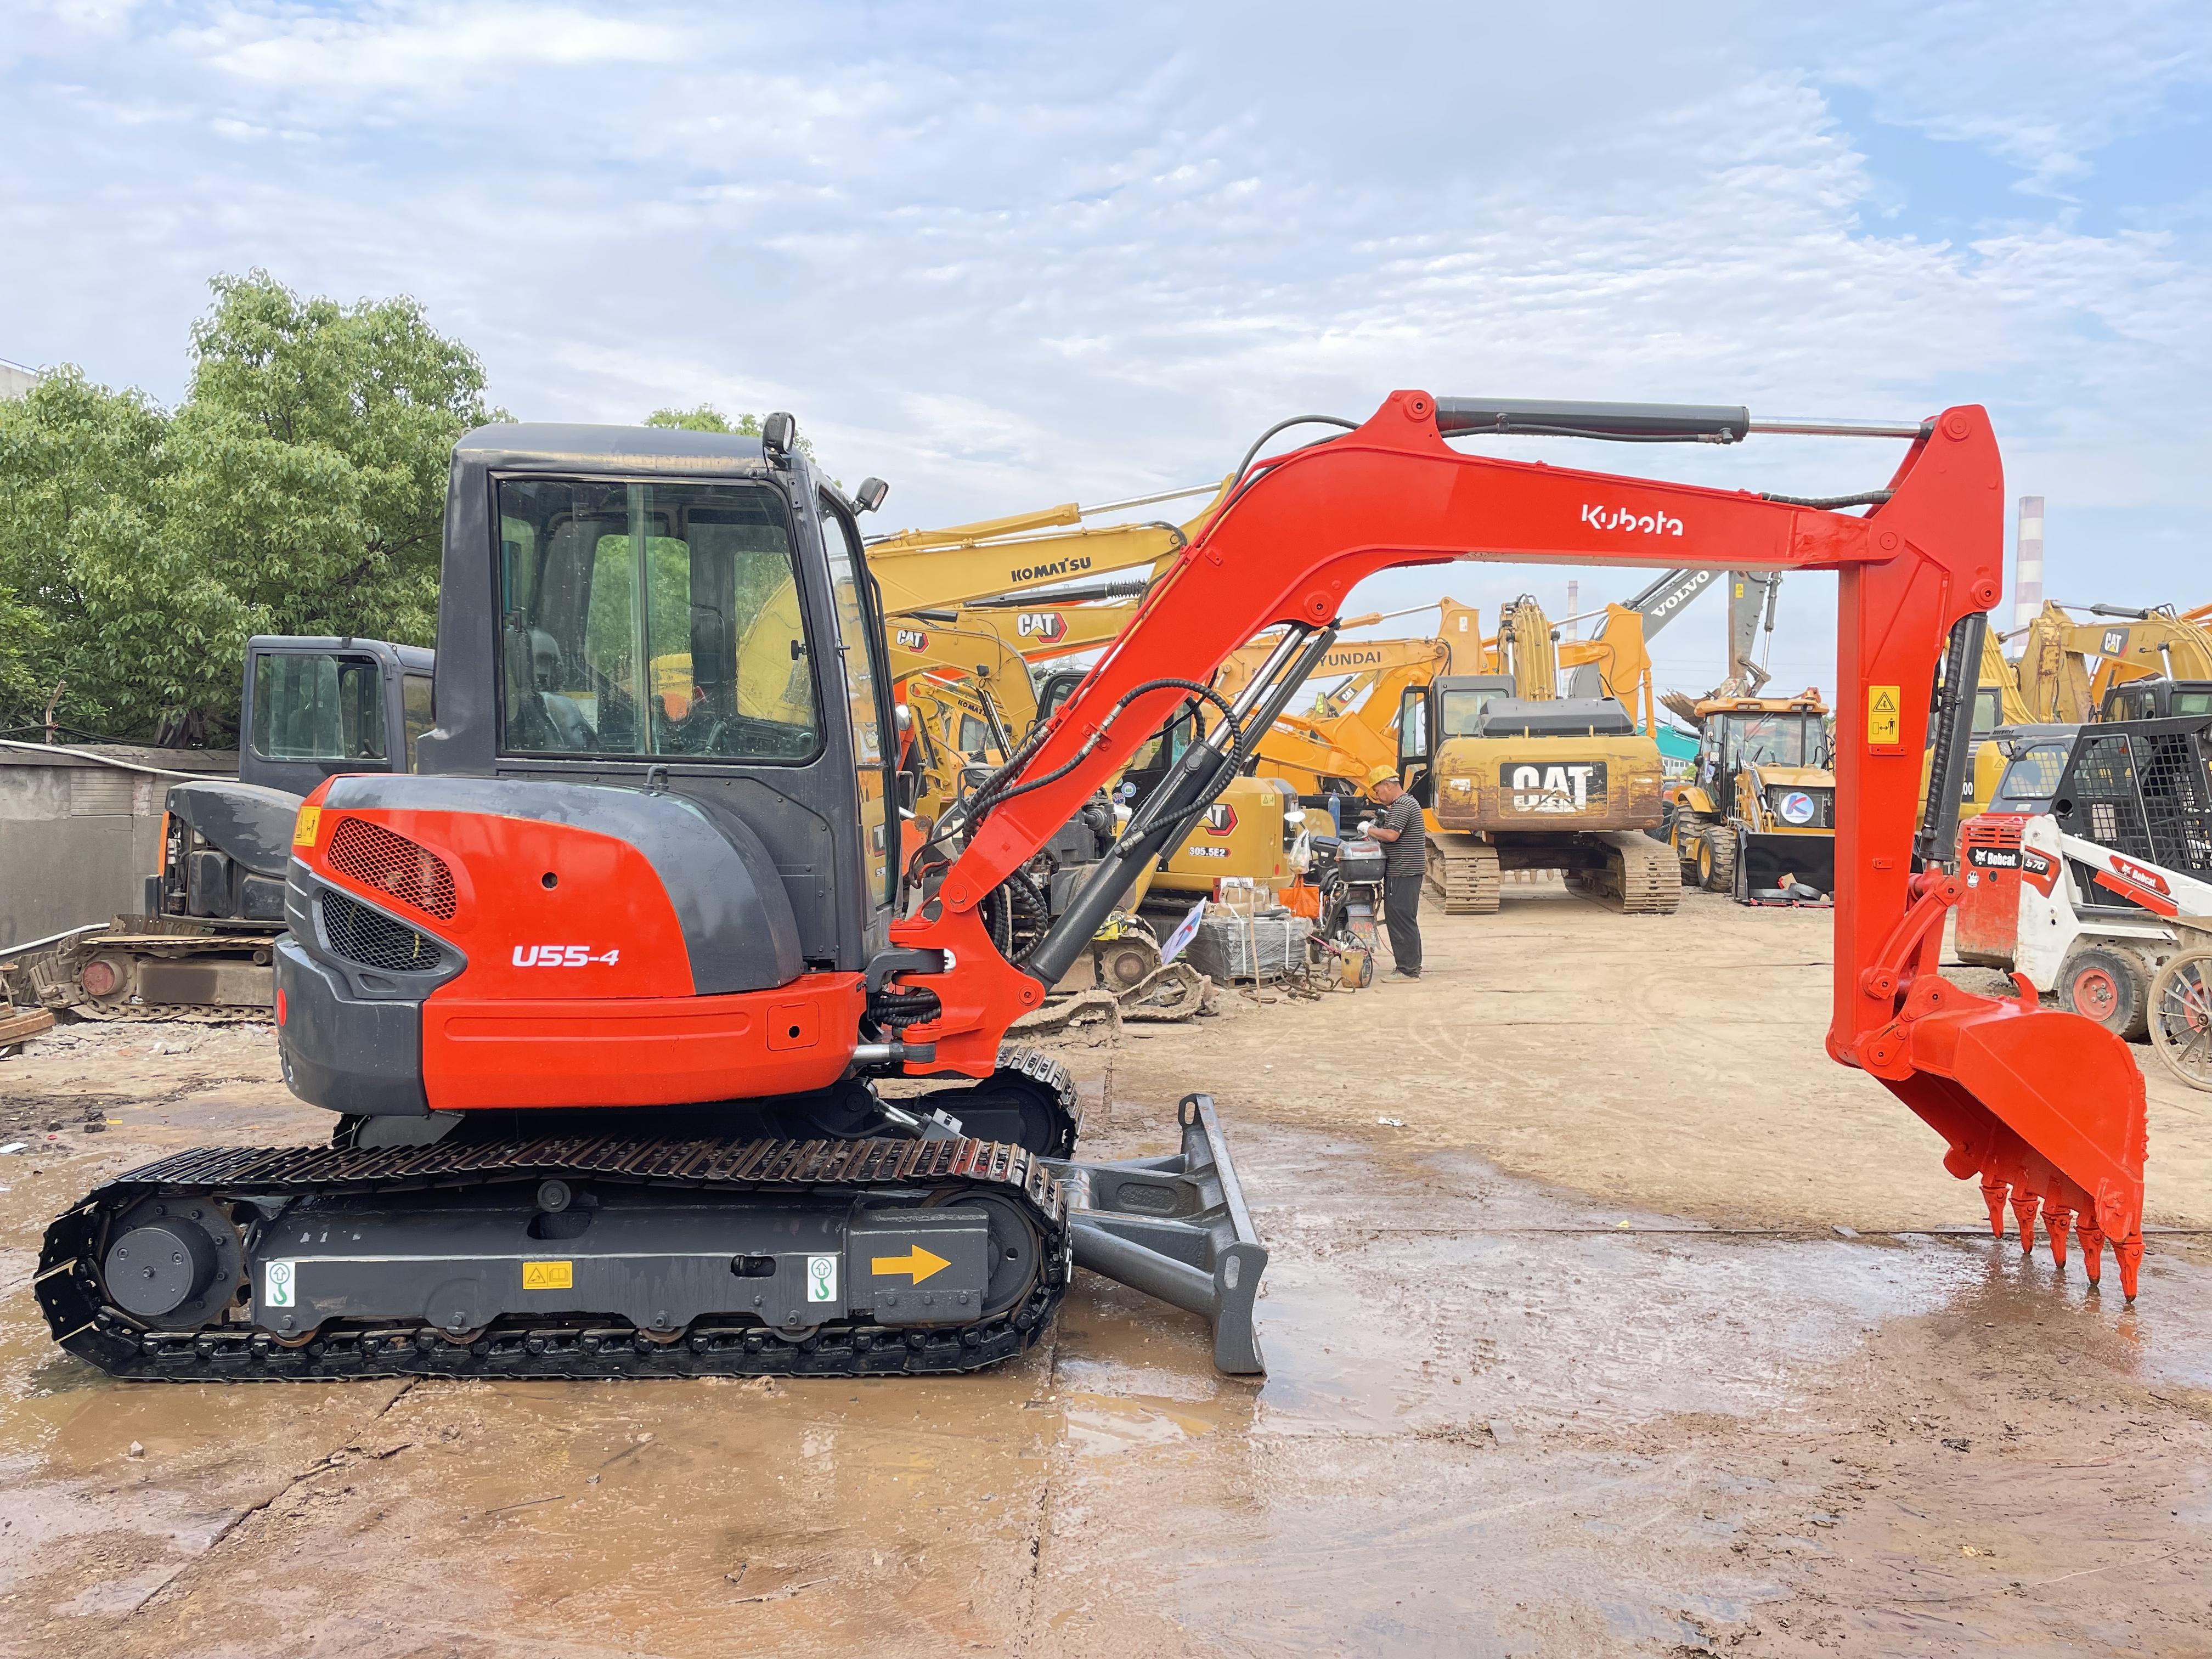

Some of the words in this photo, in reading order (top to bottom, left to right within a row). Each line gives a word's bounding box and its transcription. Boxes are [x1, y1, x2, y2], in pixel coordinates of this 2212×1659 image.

[1582, 504, 1684, 536] Kubota
[1011, 557, 1091, 582] KOMATSU
[1650, 571, 1709, 617] VOLVO
[1018, 613, 1055, 637] CAT
[897, 630, 923, 648] CAT
[2105, 633, 2122, 653] CAT
[1319, 651, 1381, 667] YUNDAI
[1342, 687, 1355, 701] CAT
[1513, 766, 1593, 812] CAT
[1962, 781, 1973, 795] 00
[1200, 804, 1226, 828] AT
[1189, 847, 1226, 857] 305.5E2
[1987, 853, 2017, 866] Bobcat
[2025, 859, 2046, 871] S70
[2132, 870, 2157, 888] Bobcat
[512, 946, 619, 967] U55-4
